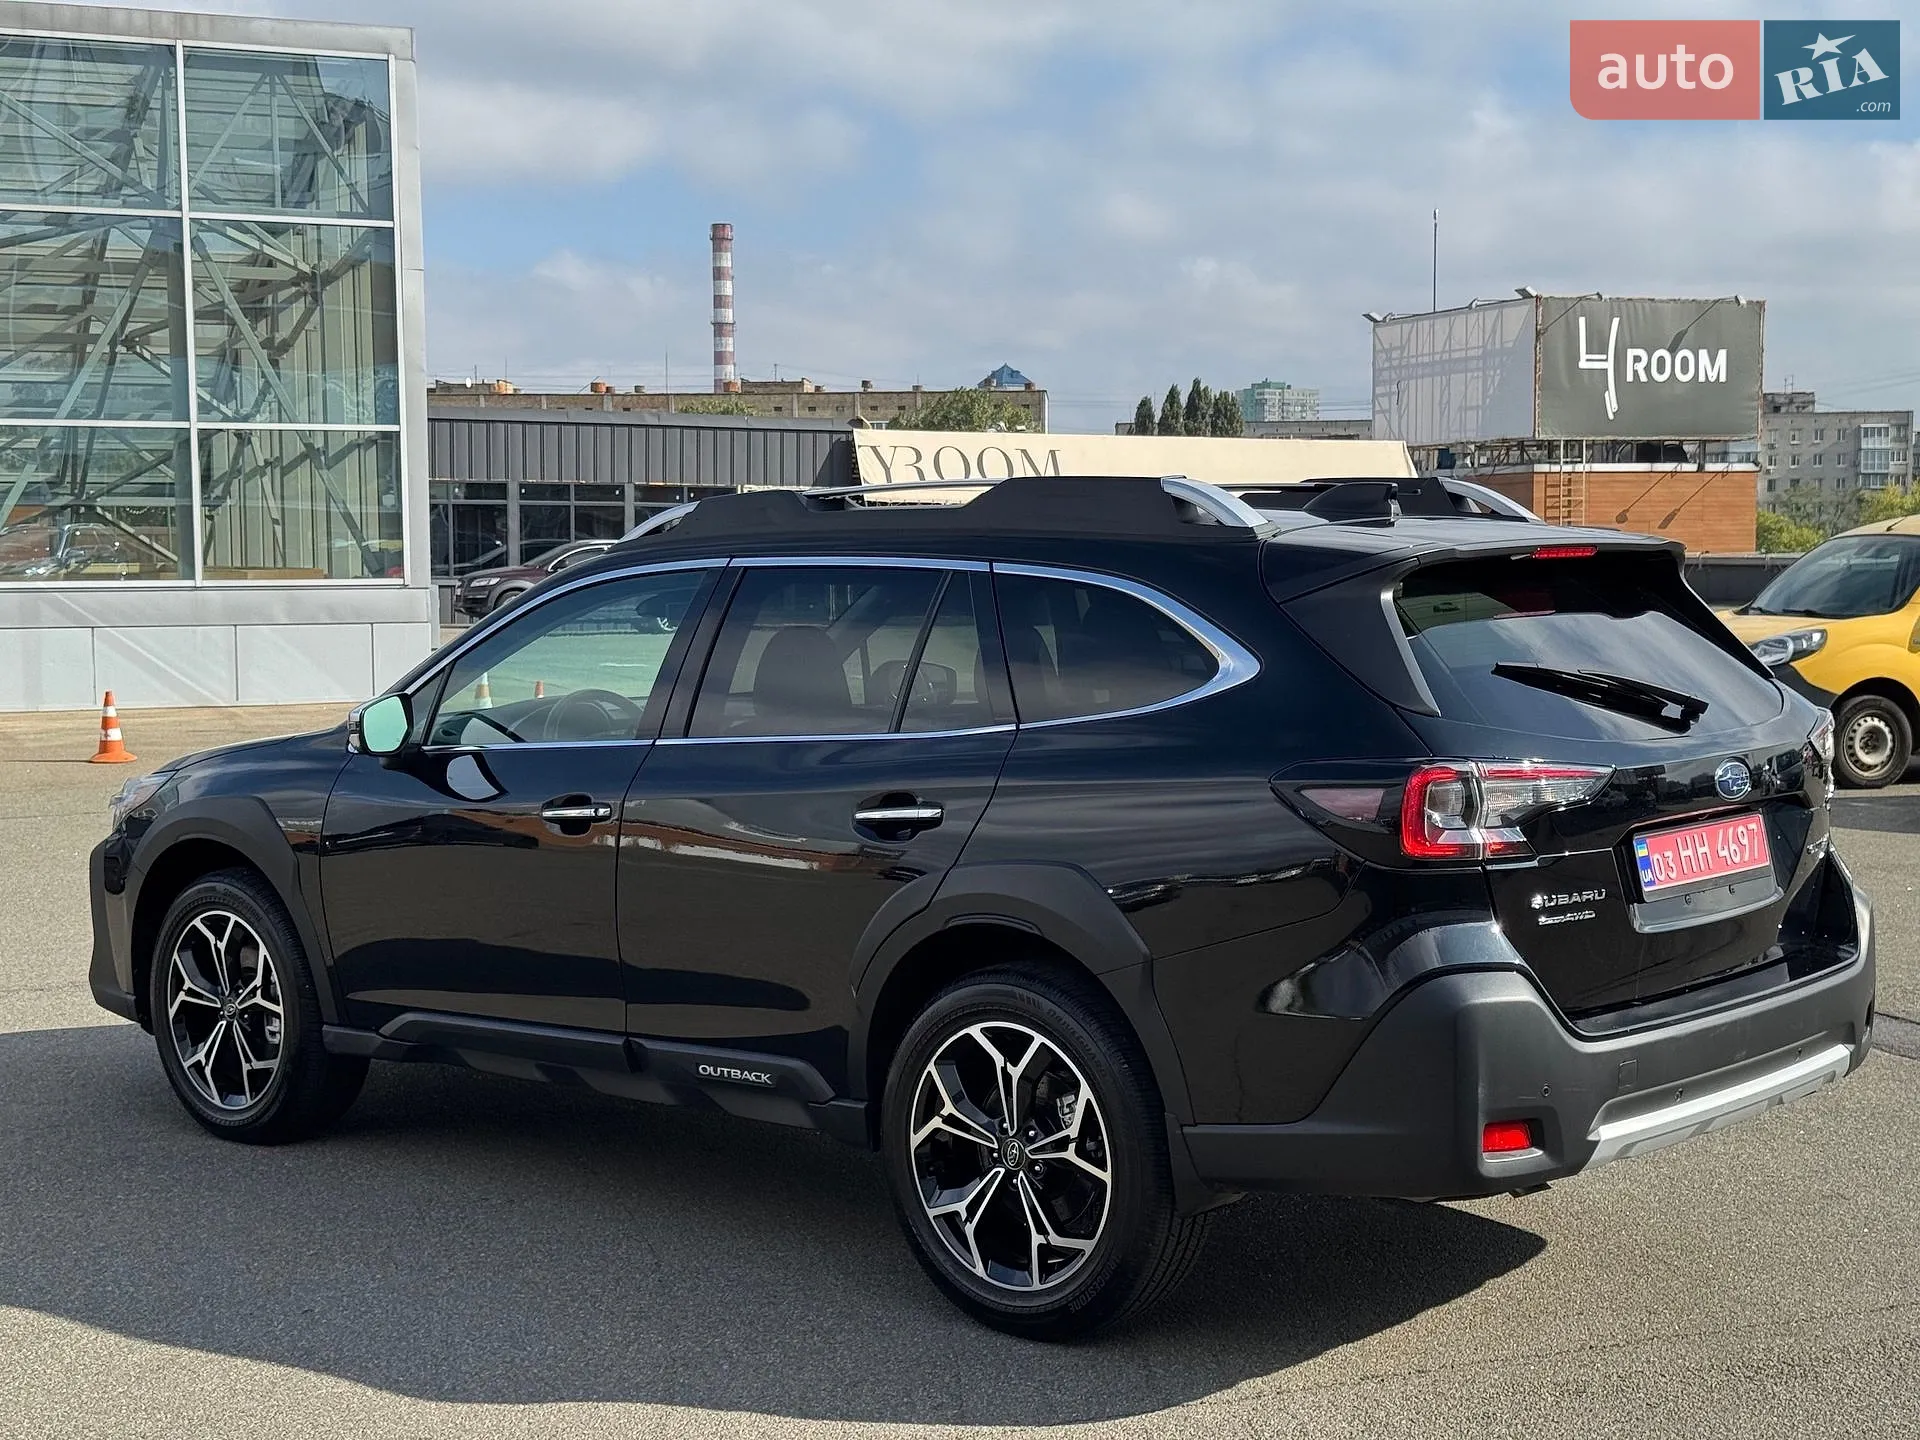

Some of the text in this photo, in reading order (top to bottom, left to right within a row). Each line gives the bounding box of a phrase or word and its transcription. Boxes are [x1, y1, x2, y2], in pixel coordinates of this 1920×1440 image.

[1625, 347, 1727, 383] ROOM
[858, 444, 1061, 484] YROOM
[1652, 850, 1677, 882] 03
[1675, 831, 1713, 875] HH
[1716, 822, 1759, 867] 4697
[1641, 868, 1655, 883] UA
[1531, 888, 1607, 910] SUBARU
[698, 1064, 773, 1085] OUTBACK
